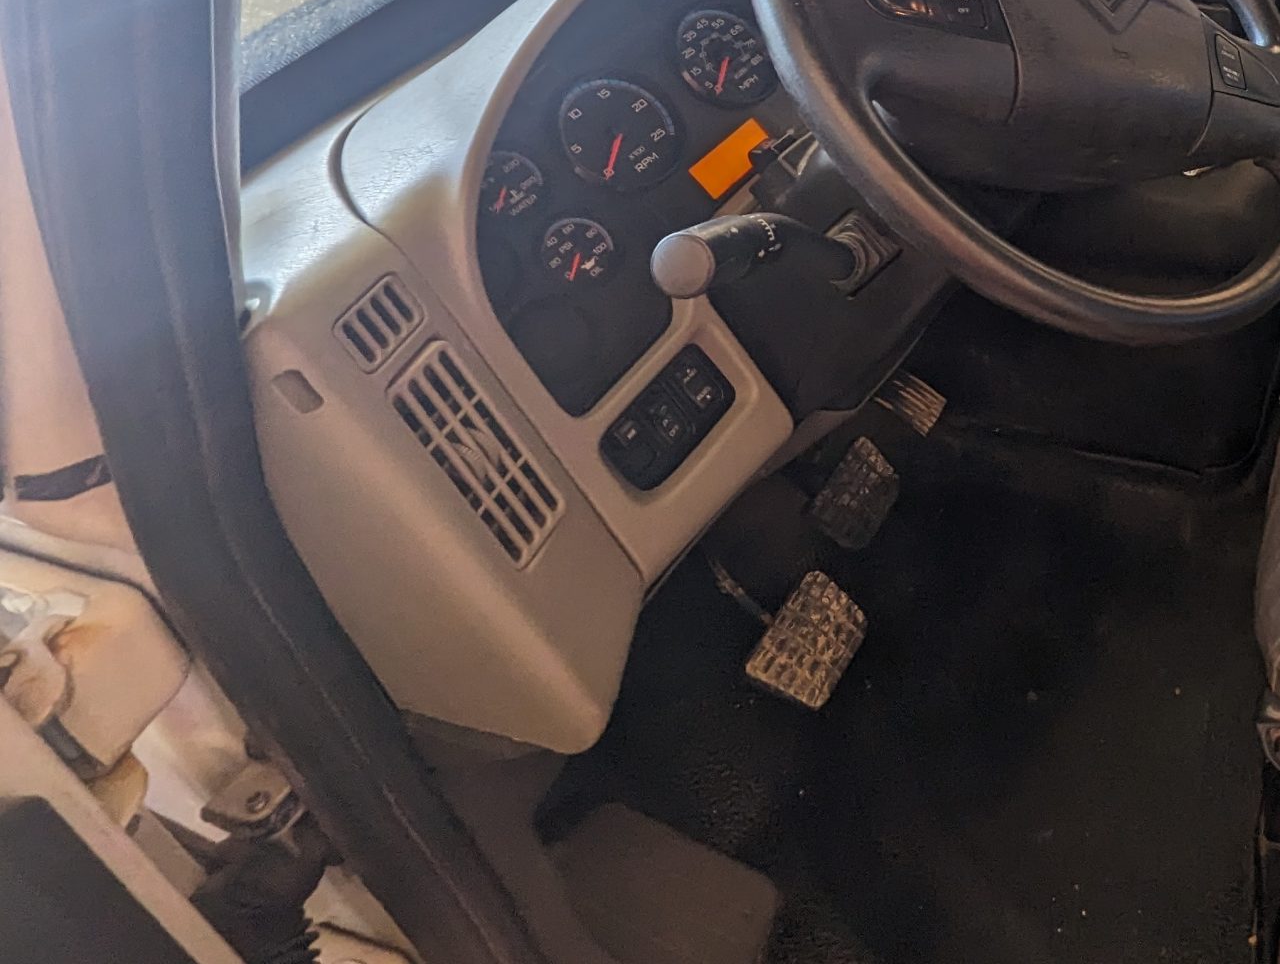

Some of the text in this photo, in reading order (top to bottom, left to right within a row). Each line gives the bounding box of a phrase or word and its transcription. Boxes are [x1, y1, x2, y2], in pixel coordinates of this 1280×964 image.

[696, 18, 709, 30] 45
[690, 66, 702, 76] 15
[738, 74, 759, 90] MPH
[597, 88, 611, 99] 15
[631, 98, 648, 113] 20
[567, 108, 582, 120] 10
[650, 128, 666, 142] 25
[570, 143, 582, 154] 5
[634, 152, 659, 172] RPM
[592, 242, 607, 255] 100
